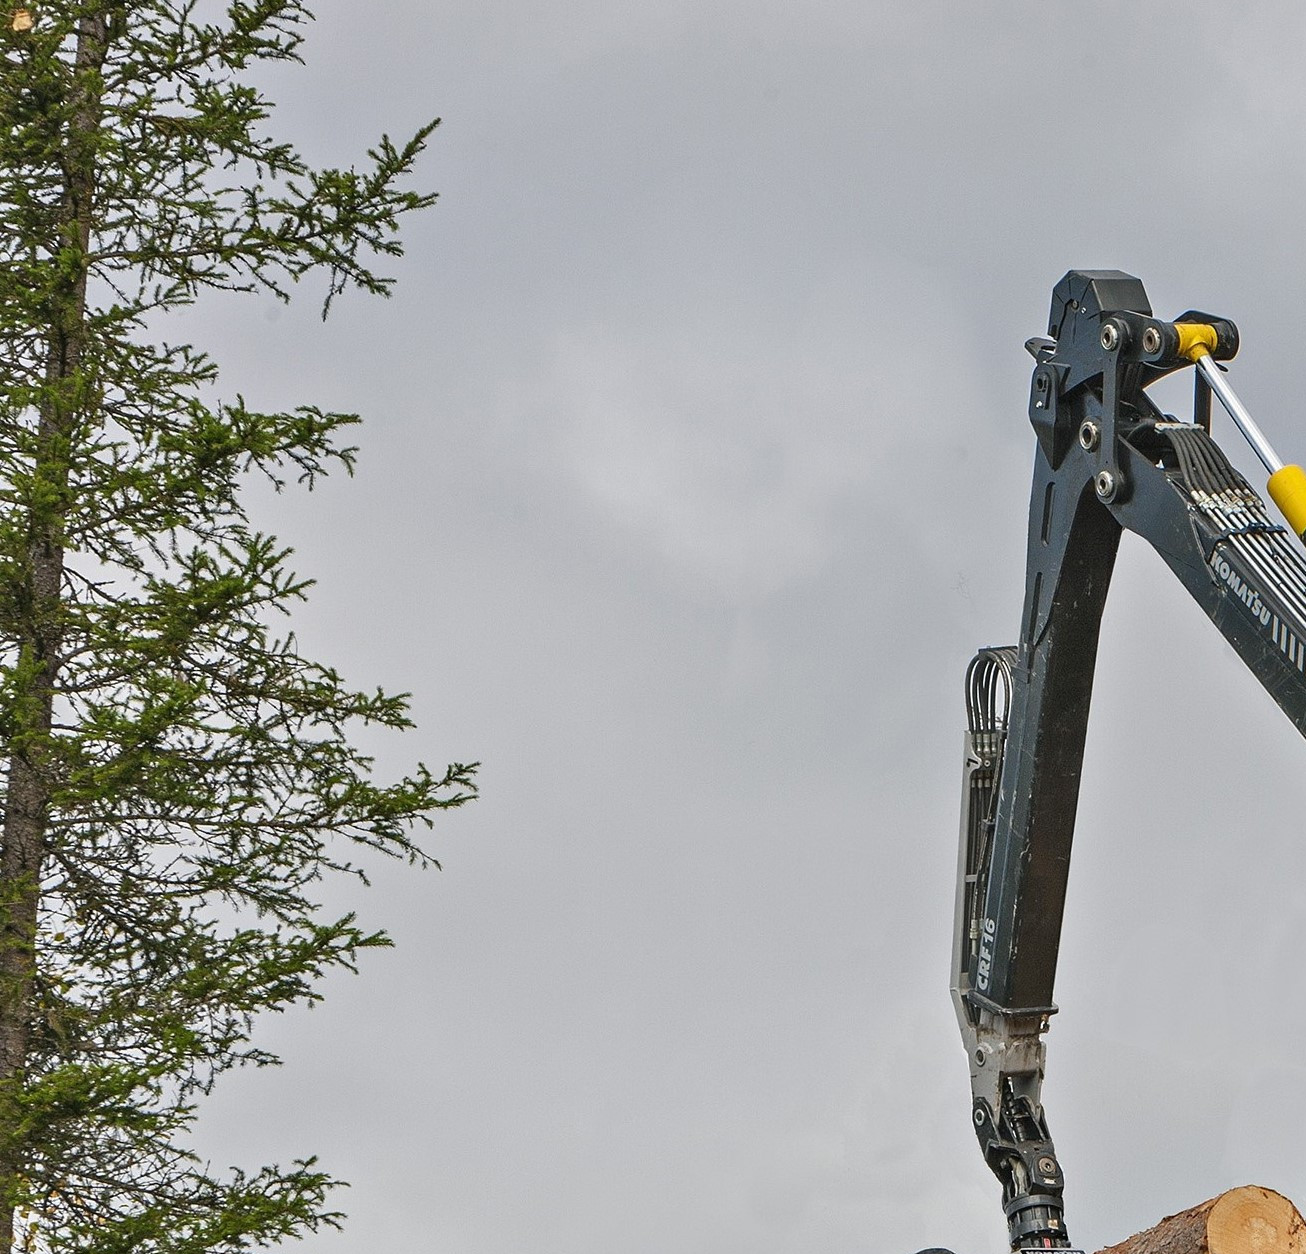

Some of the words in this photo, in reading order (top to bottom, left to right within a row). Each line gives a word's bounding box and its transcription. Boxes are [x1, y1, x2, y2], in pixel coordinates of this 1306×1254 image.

[1210, 551, 1271, 625] KOMATSU
[984, 917, 995, 943] 16
[978, 946, 991, 990] CRF
